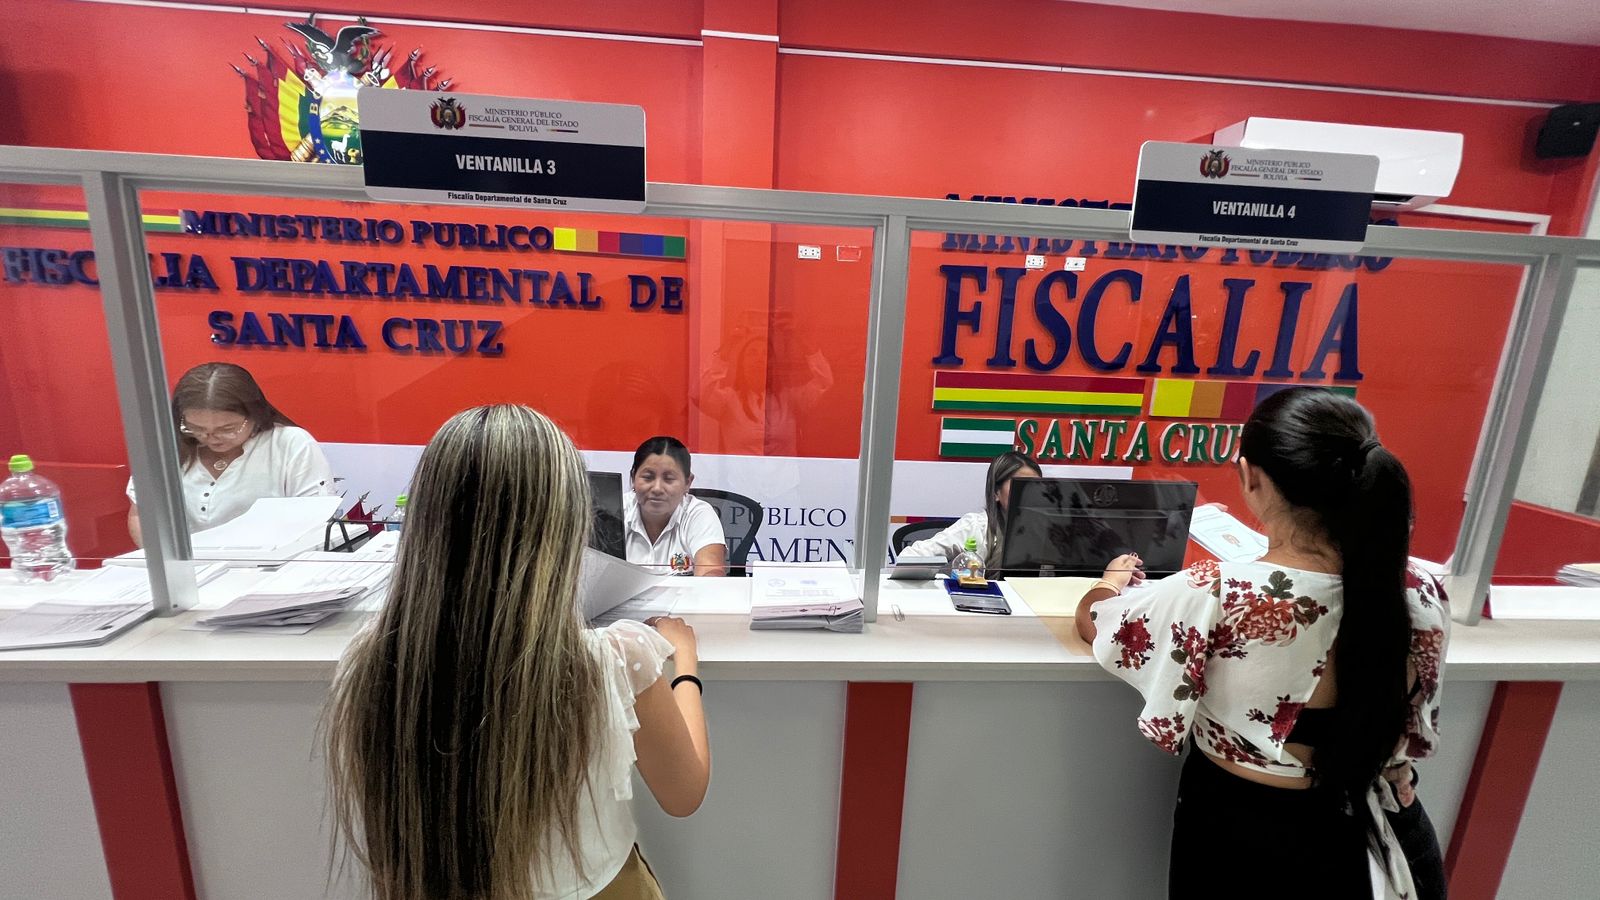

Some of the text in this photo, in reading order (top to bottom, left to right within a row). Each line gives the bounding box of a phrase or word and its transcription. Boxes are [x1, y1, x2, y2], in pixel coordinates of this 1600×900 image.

[485, 108, 529, 117] MINISTERIO
[468, 114, 579, 128] FISCALÍA GENERAL DEL ESTADO
[508, 124, 539, 133] BOLIVIA
[455, 154, 556, 175] VENTANILLA 3
[1246, 159, 1283, 167] MINISTERIO
[1258, 166, 1286, 174] GENERAL
[1263, 173, 1288, 181] BOLIVIA
[475, 193, 522, 203] Departamental
[533, 197, 551, 205] Santa
[1212, 201, 1296, 219] VENTANILLA 4
[183, 209, 553, 250] MINISTERIO PUBLICO
[2, 247, 684, 310] FISCIA DEPARTAMENTAL DE
[932, 264, 1363, 380] FISCALIA
[208, 310, 504, 353] SANTA CRUZ
[1015, 418, 1245, 464] SANTA CRU
